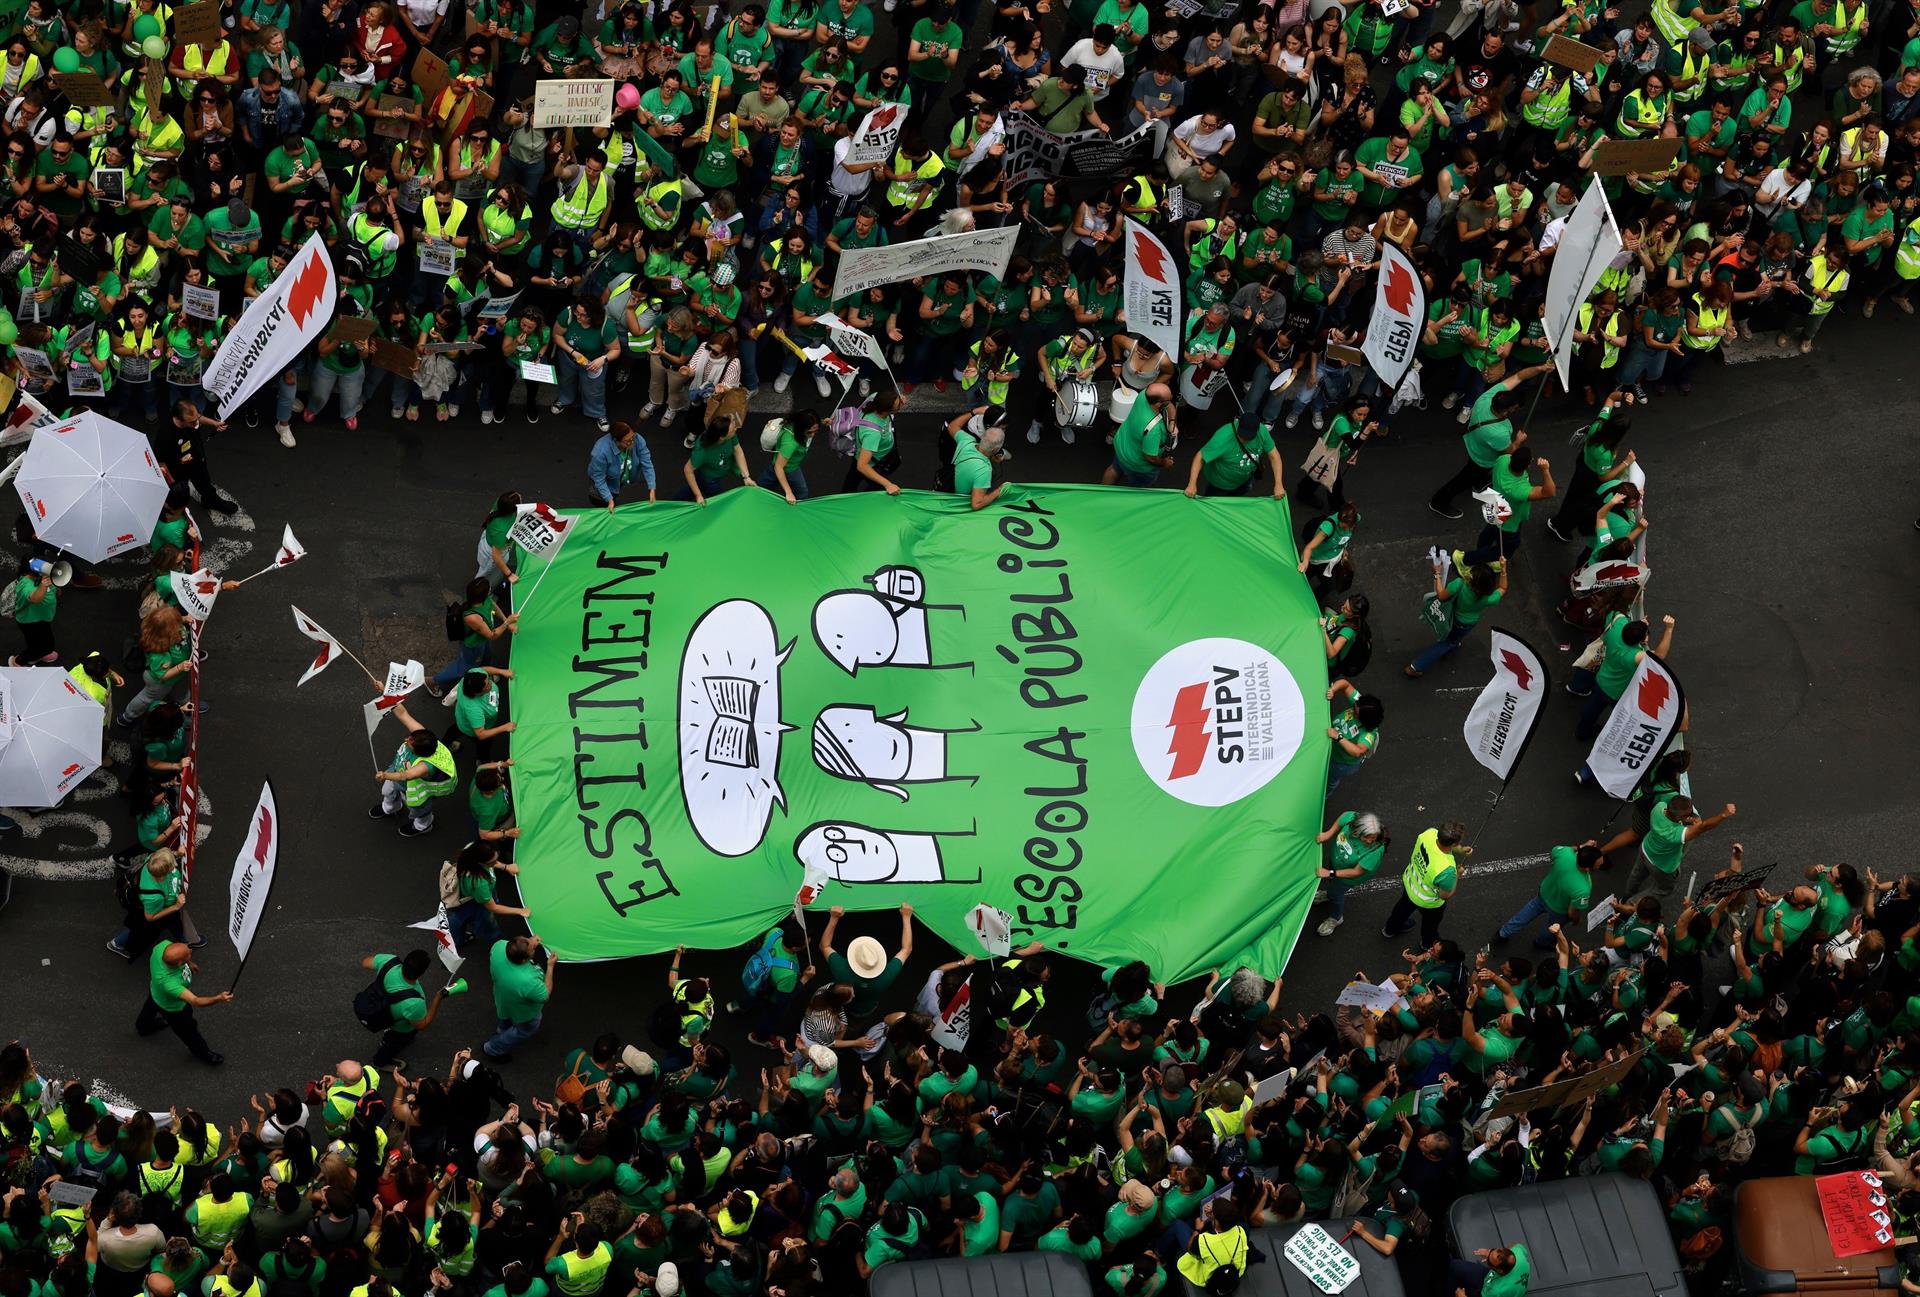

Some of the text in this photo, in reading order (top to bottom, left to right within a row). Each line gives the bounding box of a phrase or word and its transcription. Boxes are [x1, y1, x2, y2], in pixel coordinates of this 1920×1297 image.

[569, 551, 679, 917] ESTIMEM
[1212, 665, 1245, 764] STEPV
[1244, 662, 1260, 761] INTERSINDICAL
[1257, 660, 1275, 745] VALENCIANA
[1010, 727, 1088, 950] 'ESCOLA
[1310, 1227, 1356, 1269] NO ELS VEIG
[1314, 1258, 1327, 1269] ALS
[1317, 1249, 1330, 1260] ALS
[1323, 1267, 1347, 1287] ESTARAN
[1312, 1273, 1333, 1291] 8000
